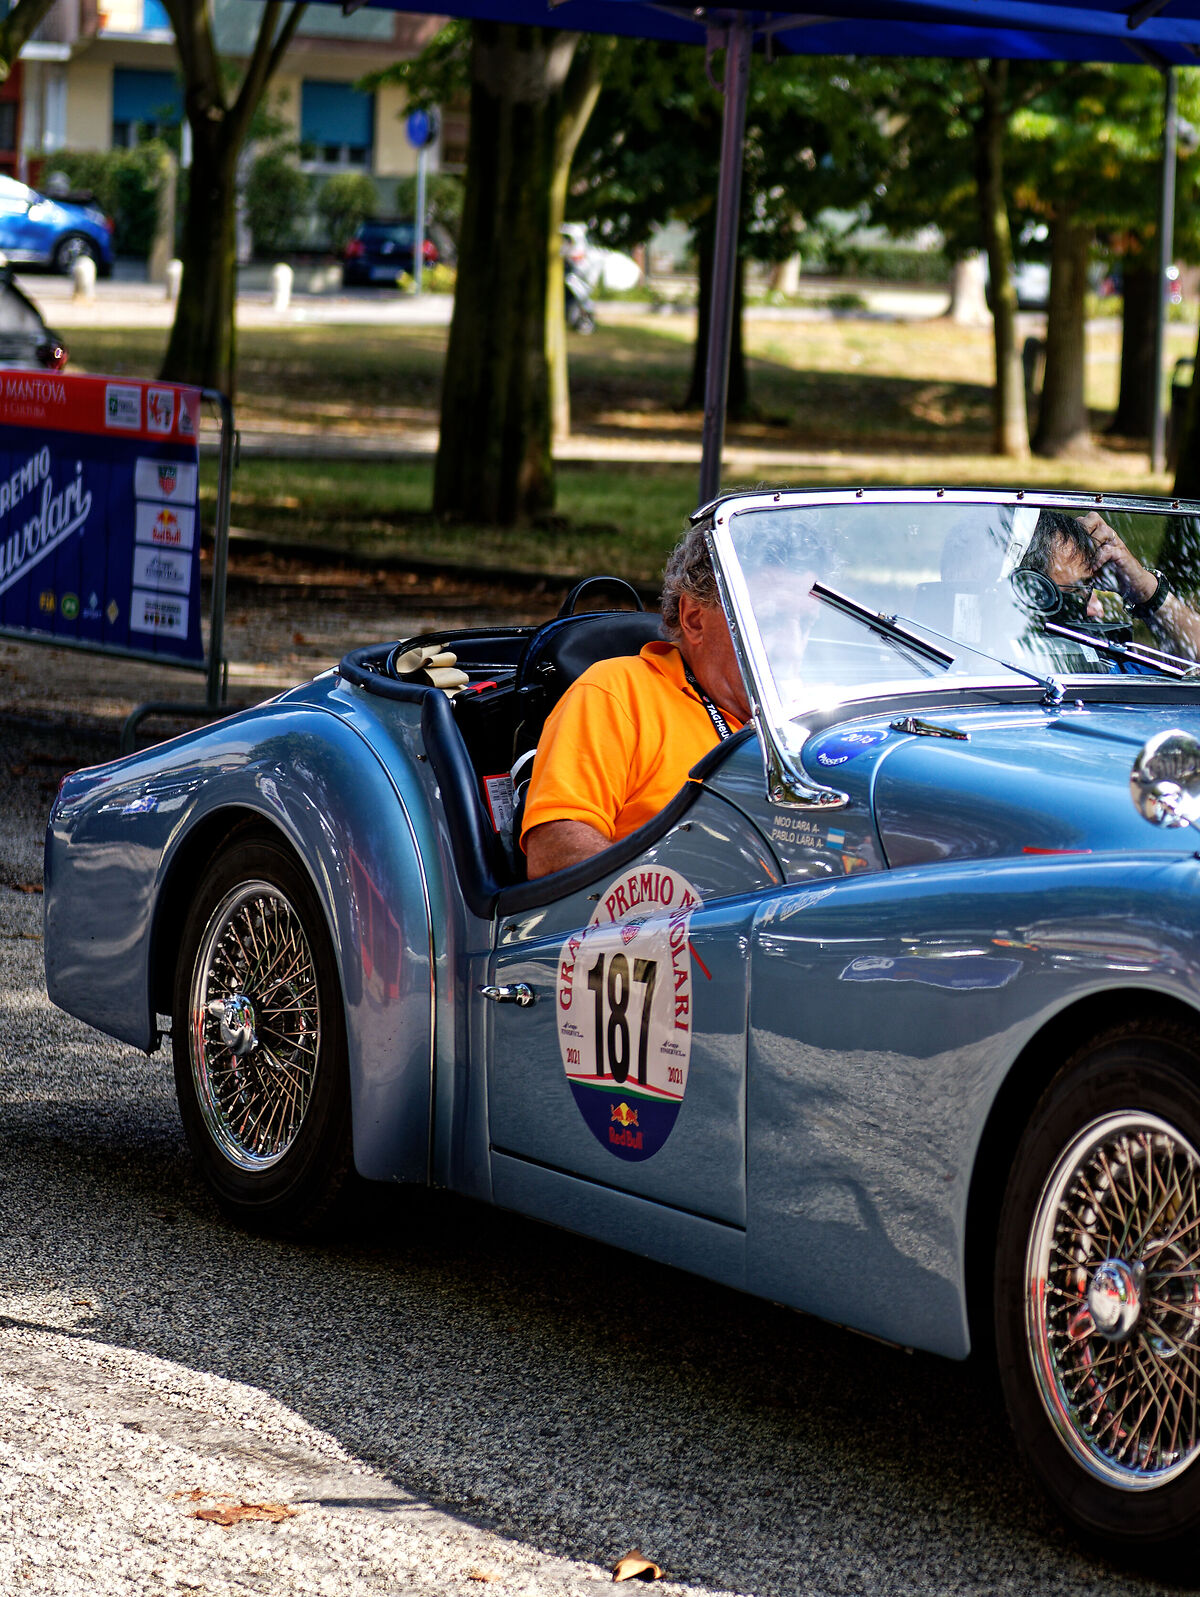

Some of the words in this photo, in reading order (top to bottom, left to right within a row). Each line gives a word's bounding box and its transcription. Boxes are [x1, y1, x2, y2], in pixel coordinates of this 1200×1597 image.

[6, 378, 66, 404] MANTOVA
[0, 445, 51, 517] REMIO
[0, 459, 88, 577] uvolari
[774, 816, 791, 828] NICO
[792, 819, 810, 832] LARA
[771, 829, 795, 843] PABLO
[796, 835, 815, 847] LARA
[605, 872, 674, 922] PREMIO
[588, 952, 658, 1085] 187
[566, 1047, 581, 1065] 2021
[668, 1066, 683, 1084] 2021
[608, 1126, 626, 1146] Red
[626, 1130, 643, 1150] Bull
